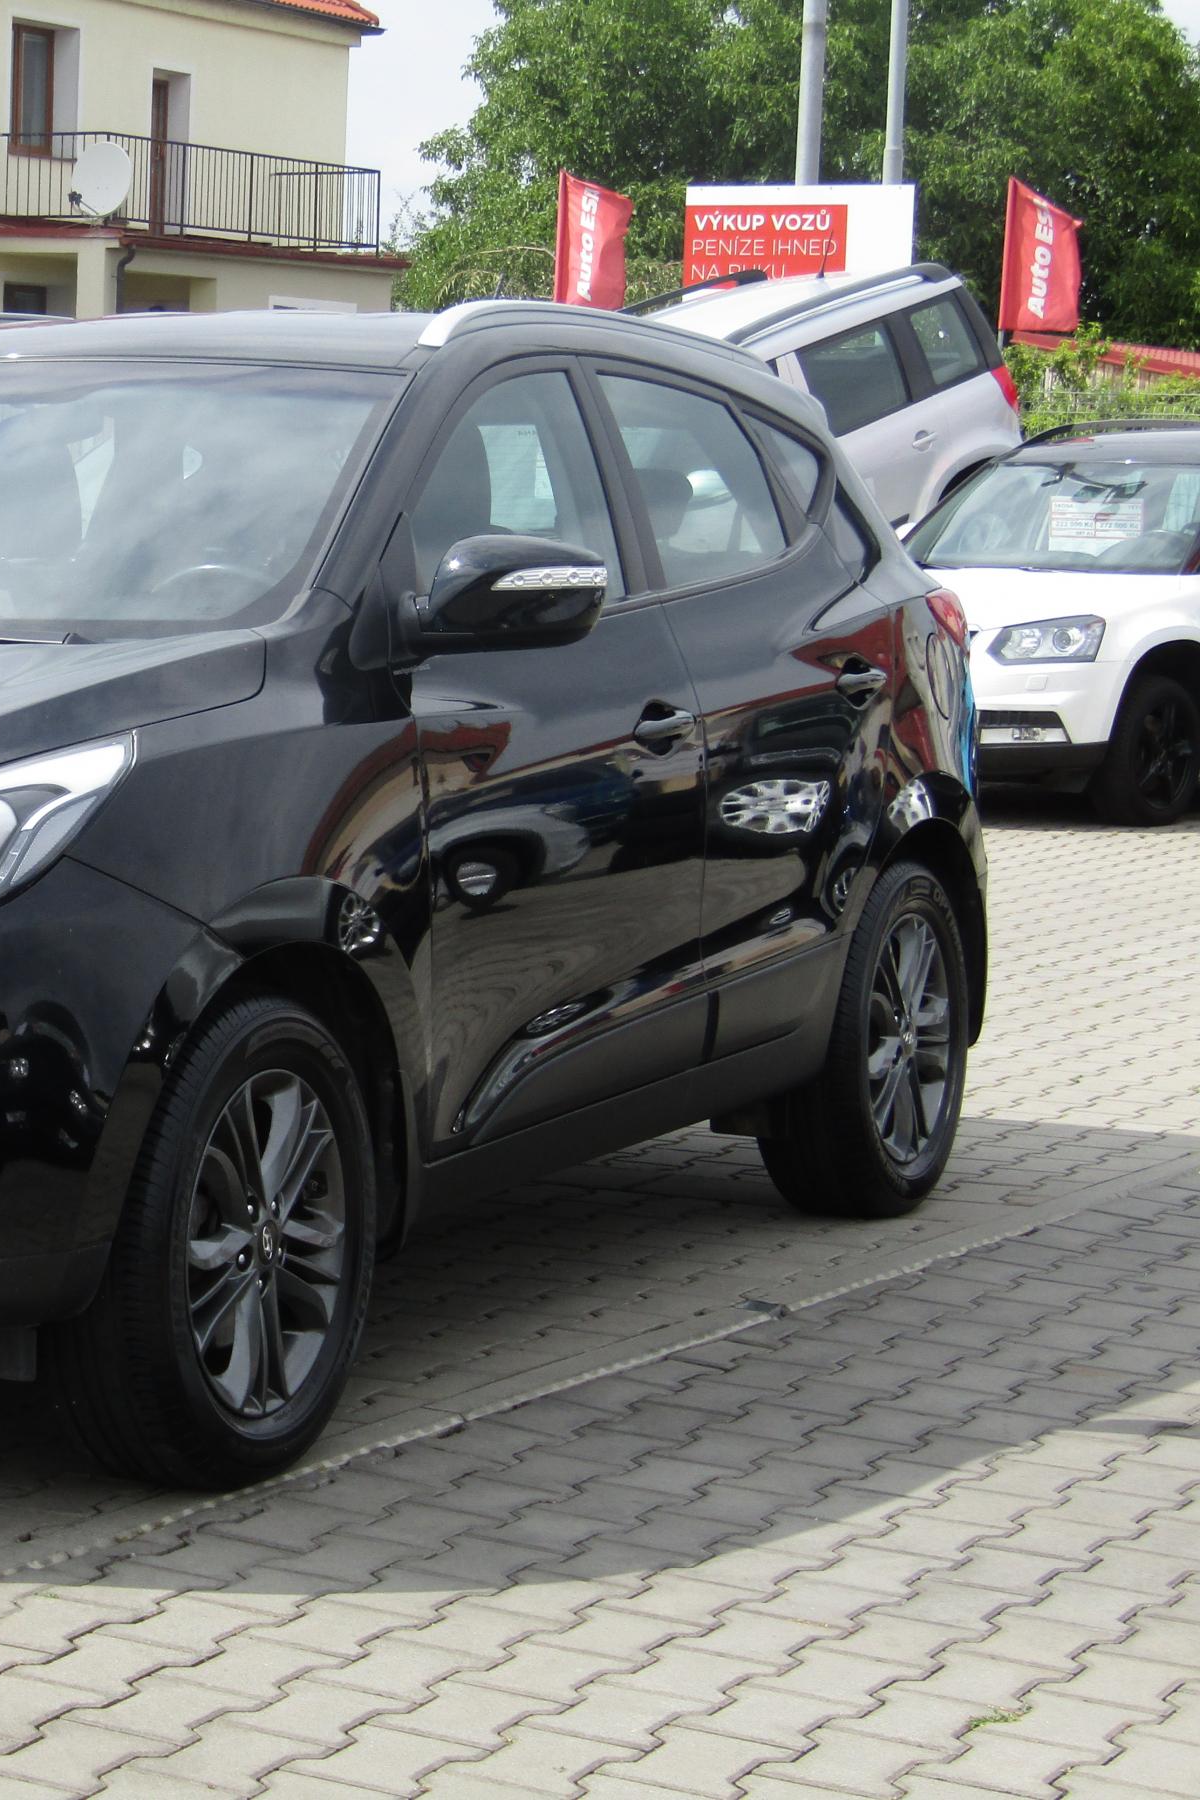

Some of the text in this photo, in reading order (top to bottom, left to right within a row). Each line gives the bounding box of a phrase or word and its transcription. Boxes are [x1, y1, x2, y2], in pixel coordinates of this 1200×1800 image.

[694, 209, 832, 231] VÝKUP VOZŮ
[692, 236, 837, 256] PENÍZE IHNED
[576, 232, 594, 302] Auto
[691, 264, 720, 281] NA
[1027, 245, 1053, 320] Auto
